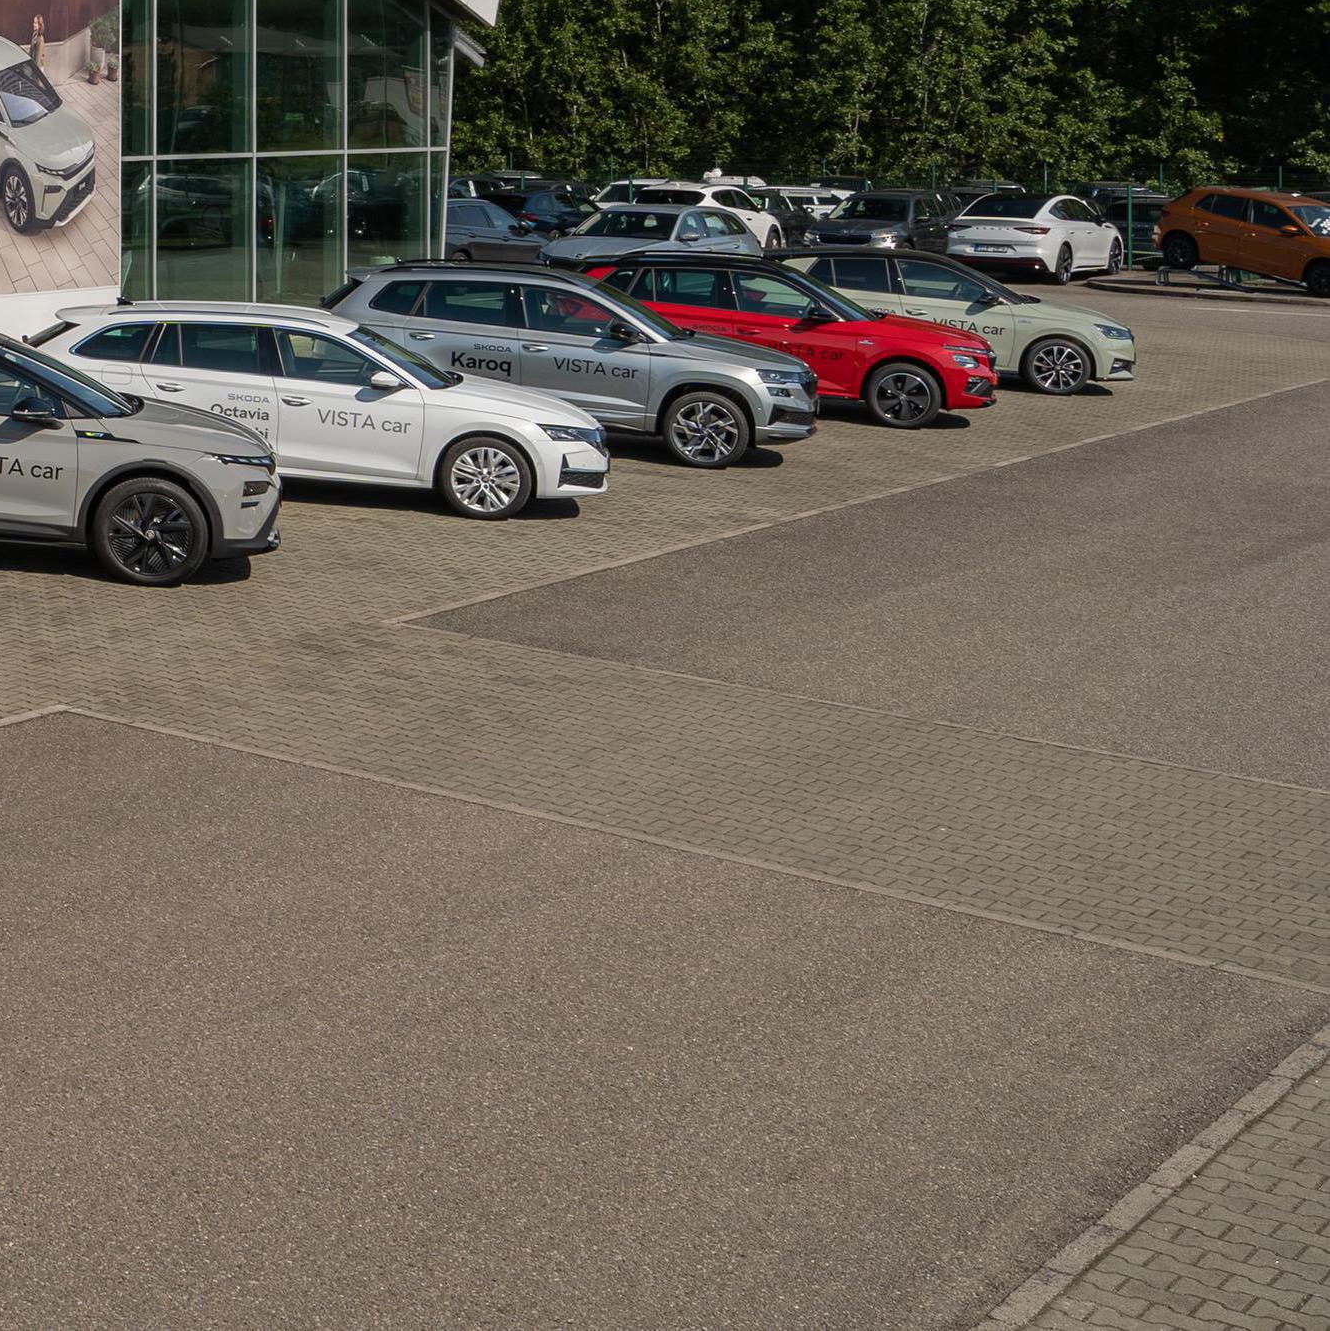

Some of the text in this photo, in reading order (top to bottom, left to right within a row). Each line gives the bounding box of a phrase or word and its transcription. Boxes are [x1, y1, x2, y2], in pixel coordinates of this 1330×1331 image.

[982, 325, 1006, 336] car
[451, 351, 512, 377] Karoq
[820, 349, 843, 360] car
[553, 356, 639, 379] VISTA car
[317, 408, 412, 434] VISTA car
[30, 463, 64, 480] car
